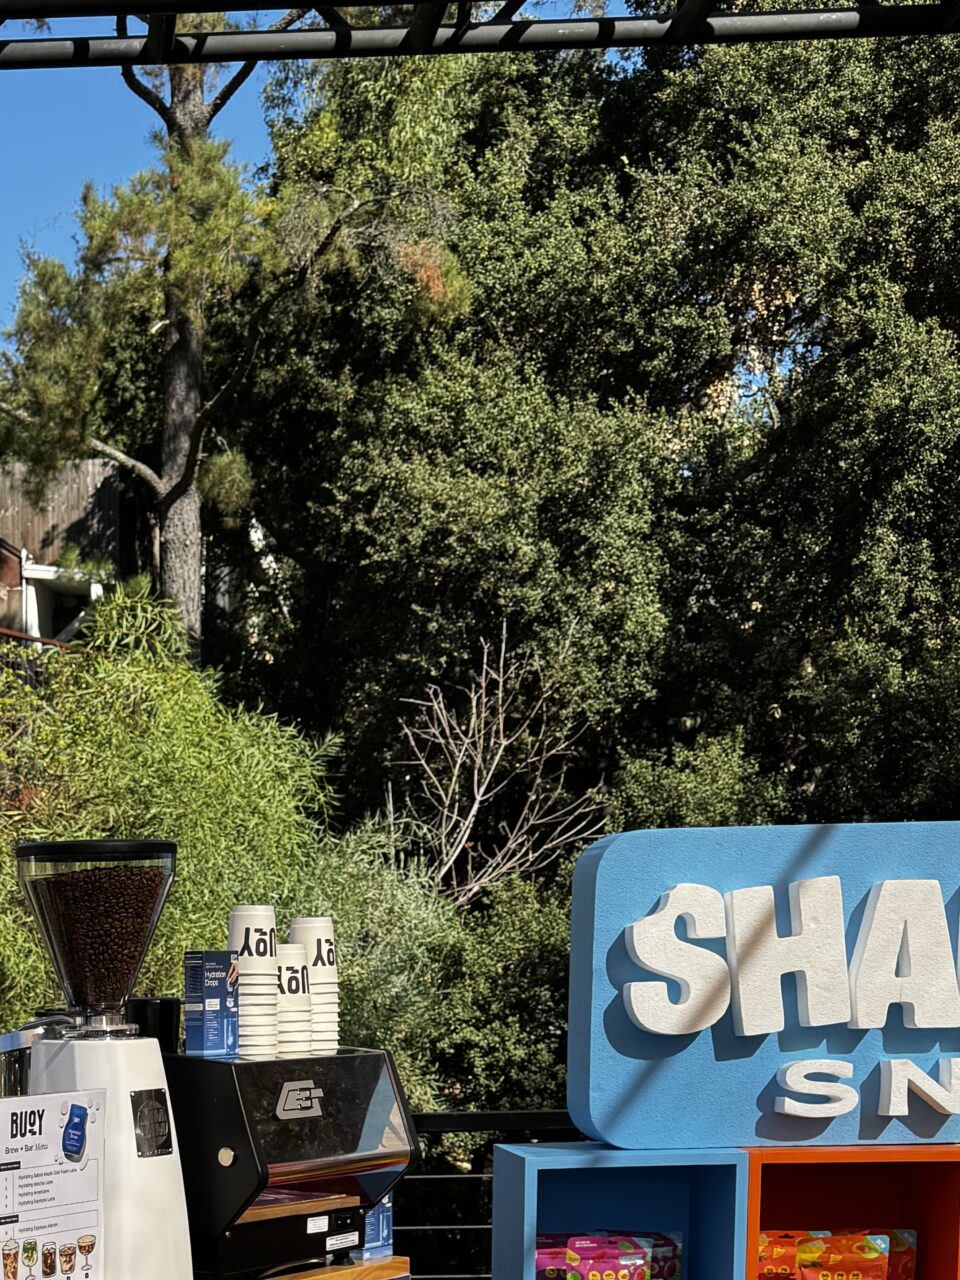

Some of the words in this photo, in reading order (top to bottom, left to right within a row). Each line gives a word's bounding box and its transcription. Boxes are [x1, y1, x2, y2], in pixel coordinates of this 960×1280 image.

[623, 875, 960, 1036] SHA
[775, 1059, 960, 1118] SN
[10, 1108, 45, 1139] BUOY
[5, 1147, 19, 1155] Brew
